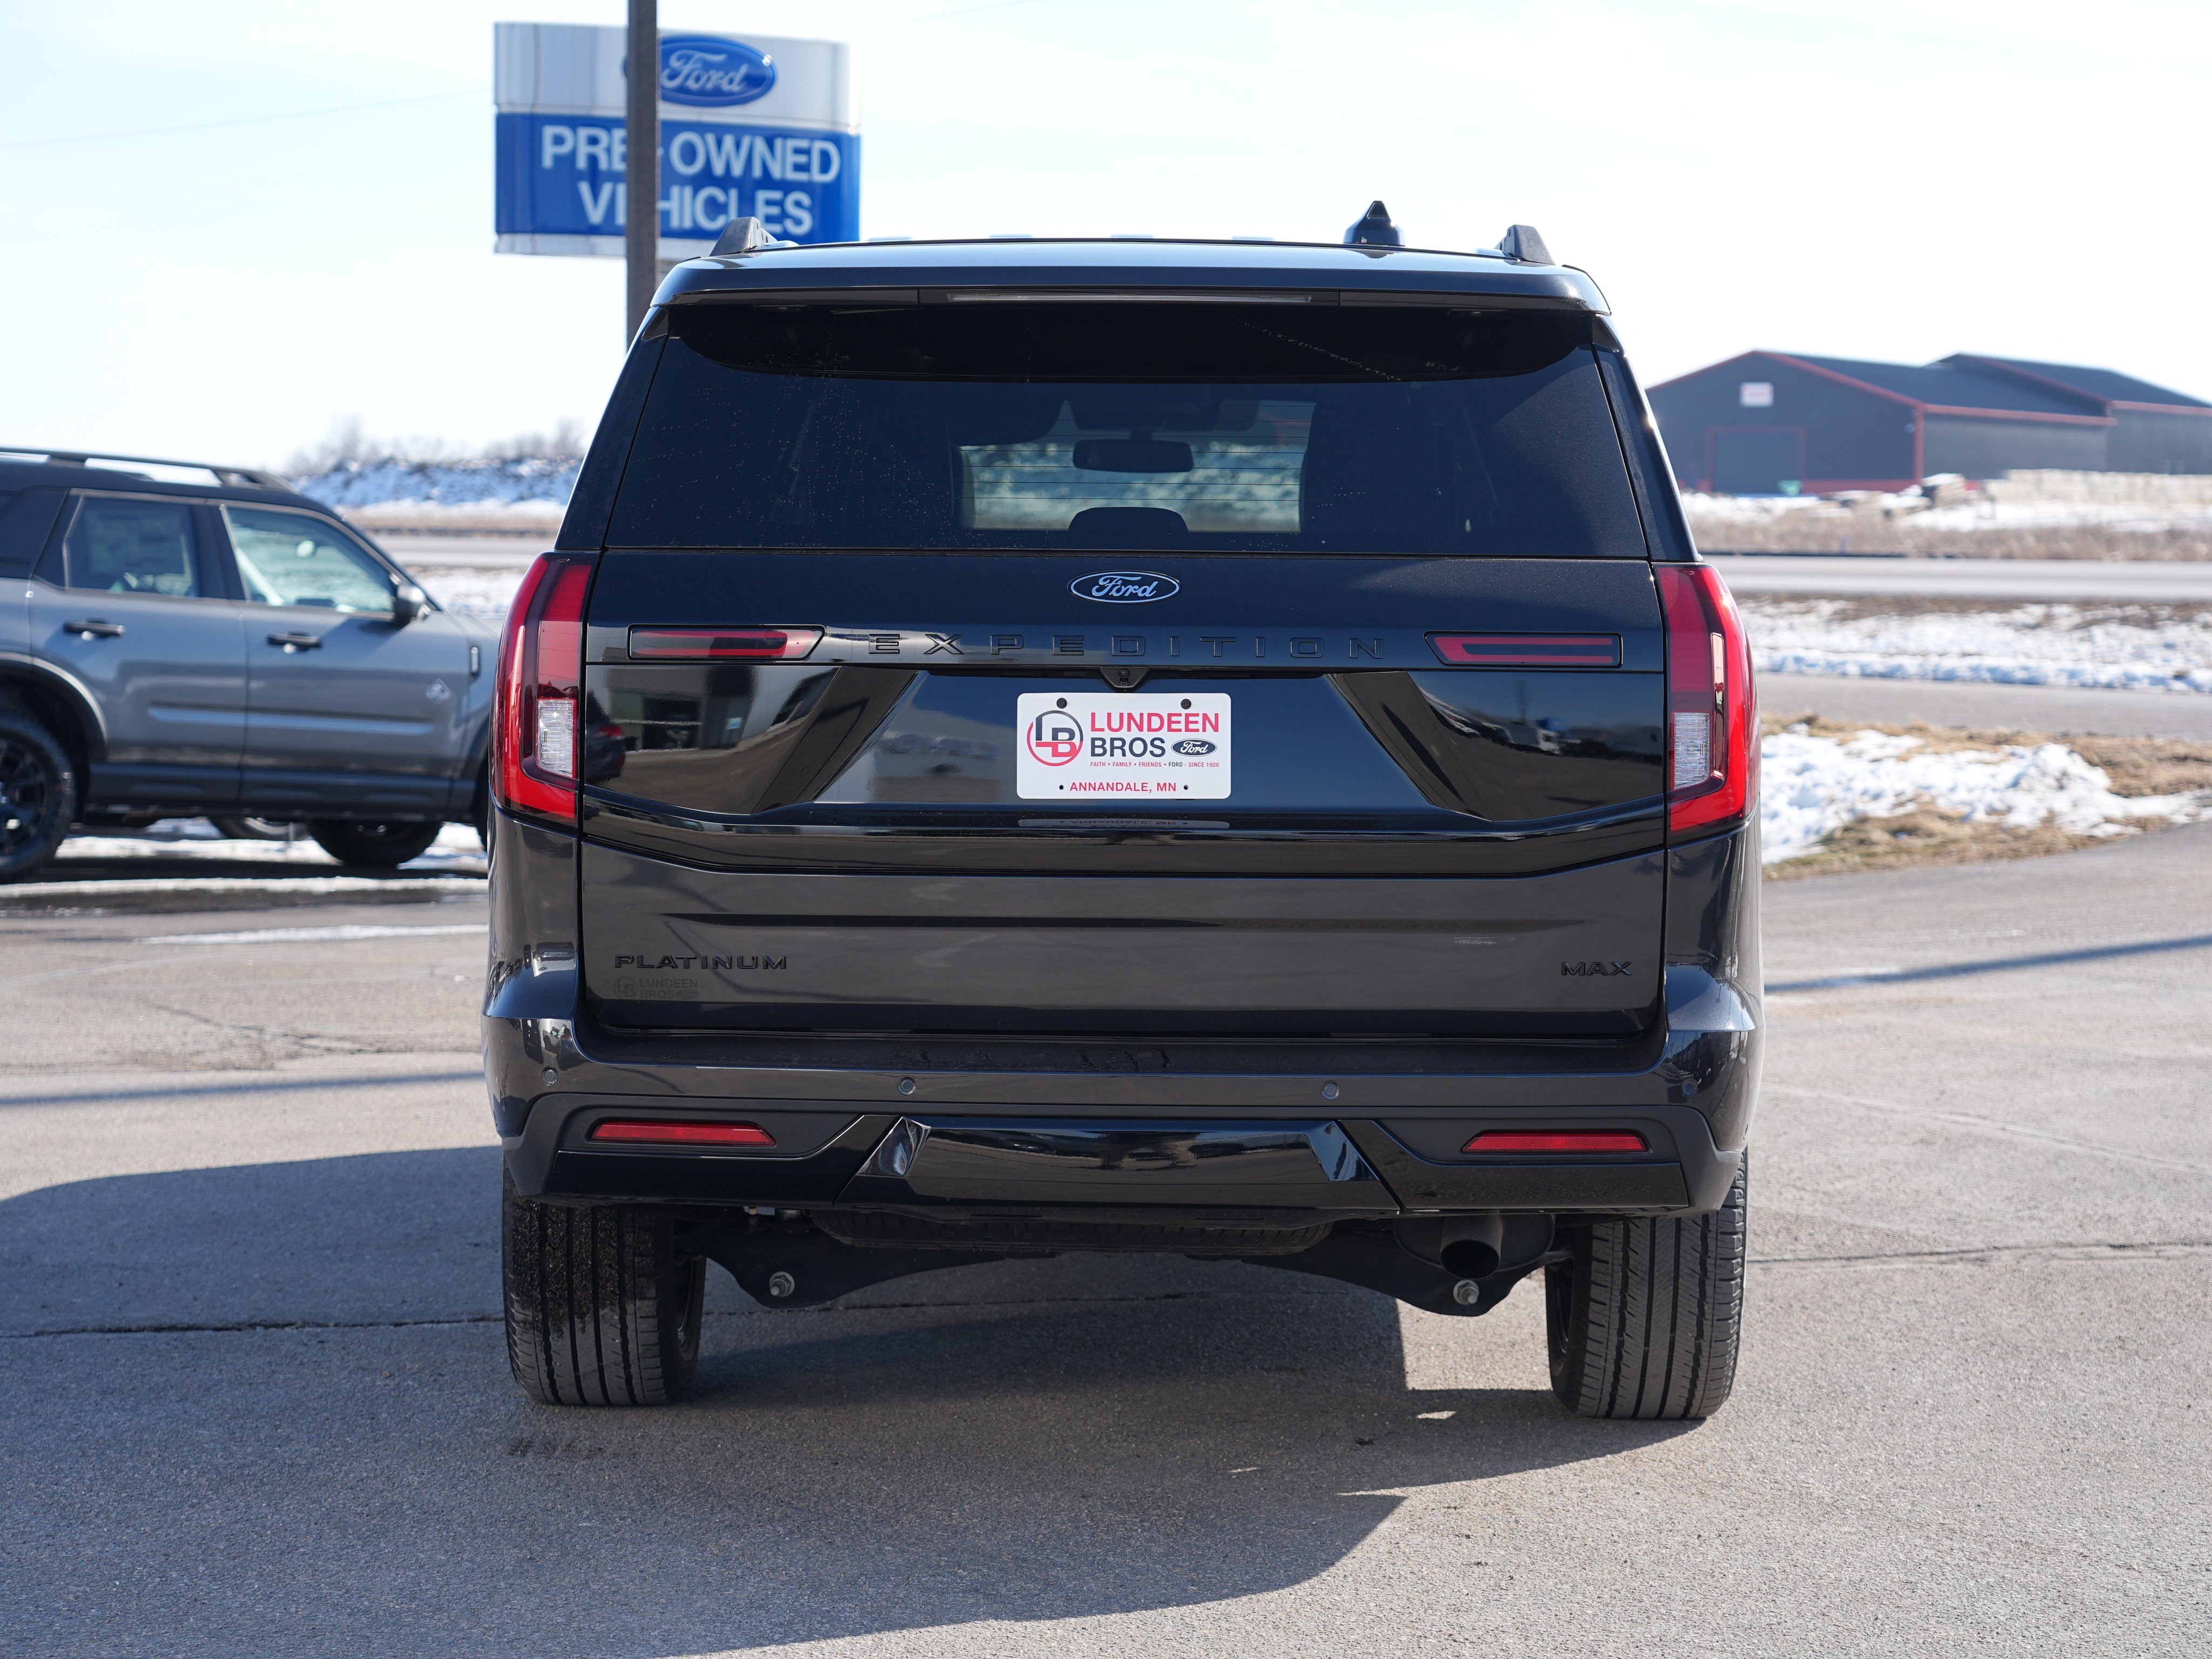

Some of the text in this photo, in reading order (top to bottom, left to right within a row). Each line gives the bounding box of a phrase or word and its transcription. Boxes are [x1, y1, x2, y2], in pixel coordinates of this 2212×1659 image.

[660, 49, 749, 92] Ford
[1091, 575, 1159, 597] Ford
[868, 633, 1384, 659] EXPEDITION
[1090, 712, 1219, 732] LUNDEEN
[1090, 737, 1166, 757] BROS
[1180, 741, 1209, 753] Ford
[1069, 782, 1176, 793] ANNANDALE, MN
[615, 954, 787, 969] PLATINUM
[1561, 961, 1633, 976] MAX
[639, 979, 698, 988] LUNDEEN
[640, 989, 675, 999] BROS
